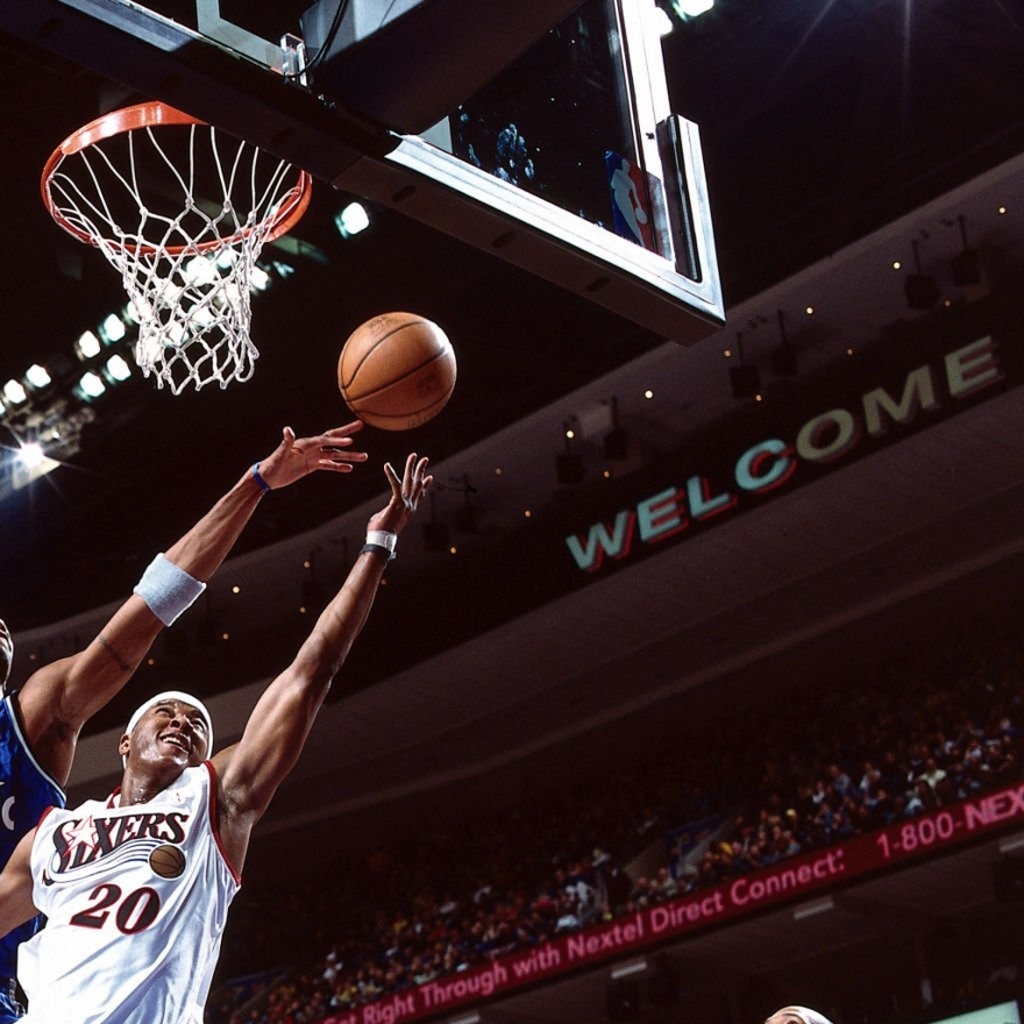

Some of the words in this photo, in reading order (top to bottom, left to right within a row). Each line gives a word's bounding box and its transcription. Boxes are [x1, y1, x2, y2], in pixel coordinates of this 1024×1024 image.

[565, 336, 1005, 573] WELCOME
[52, 812, 189, 874] SIXERS
[69, 883, 161, 936] 20
[419, 962, 507, 1008] Through
[513, 944, 561, 978] with
[567, 914, 643, 960] Nextel
[651, 890, 724, 934] Direct
[730, 848, 846, 906] Connect:
